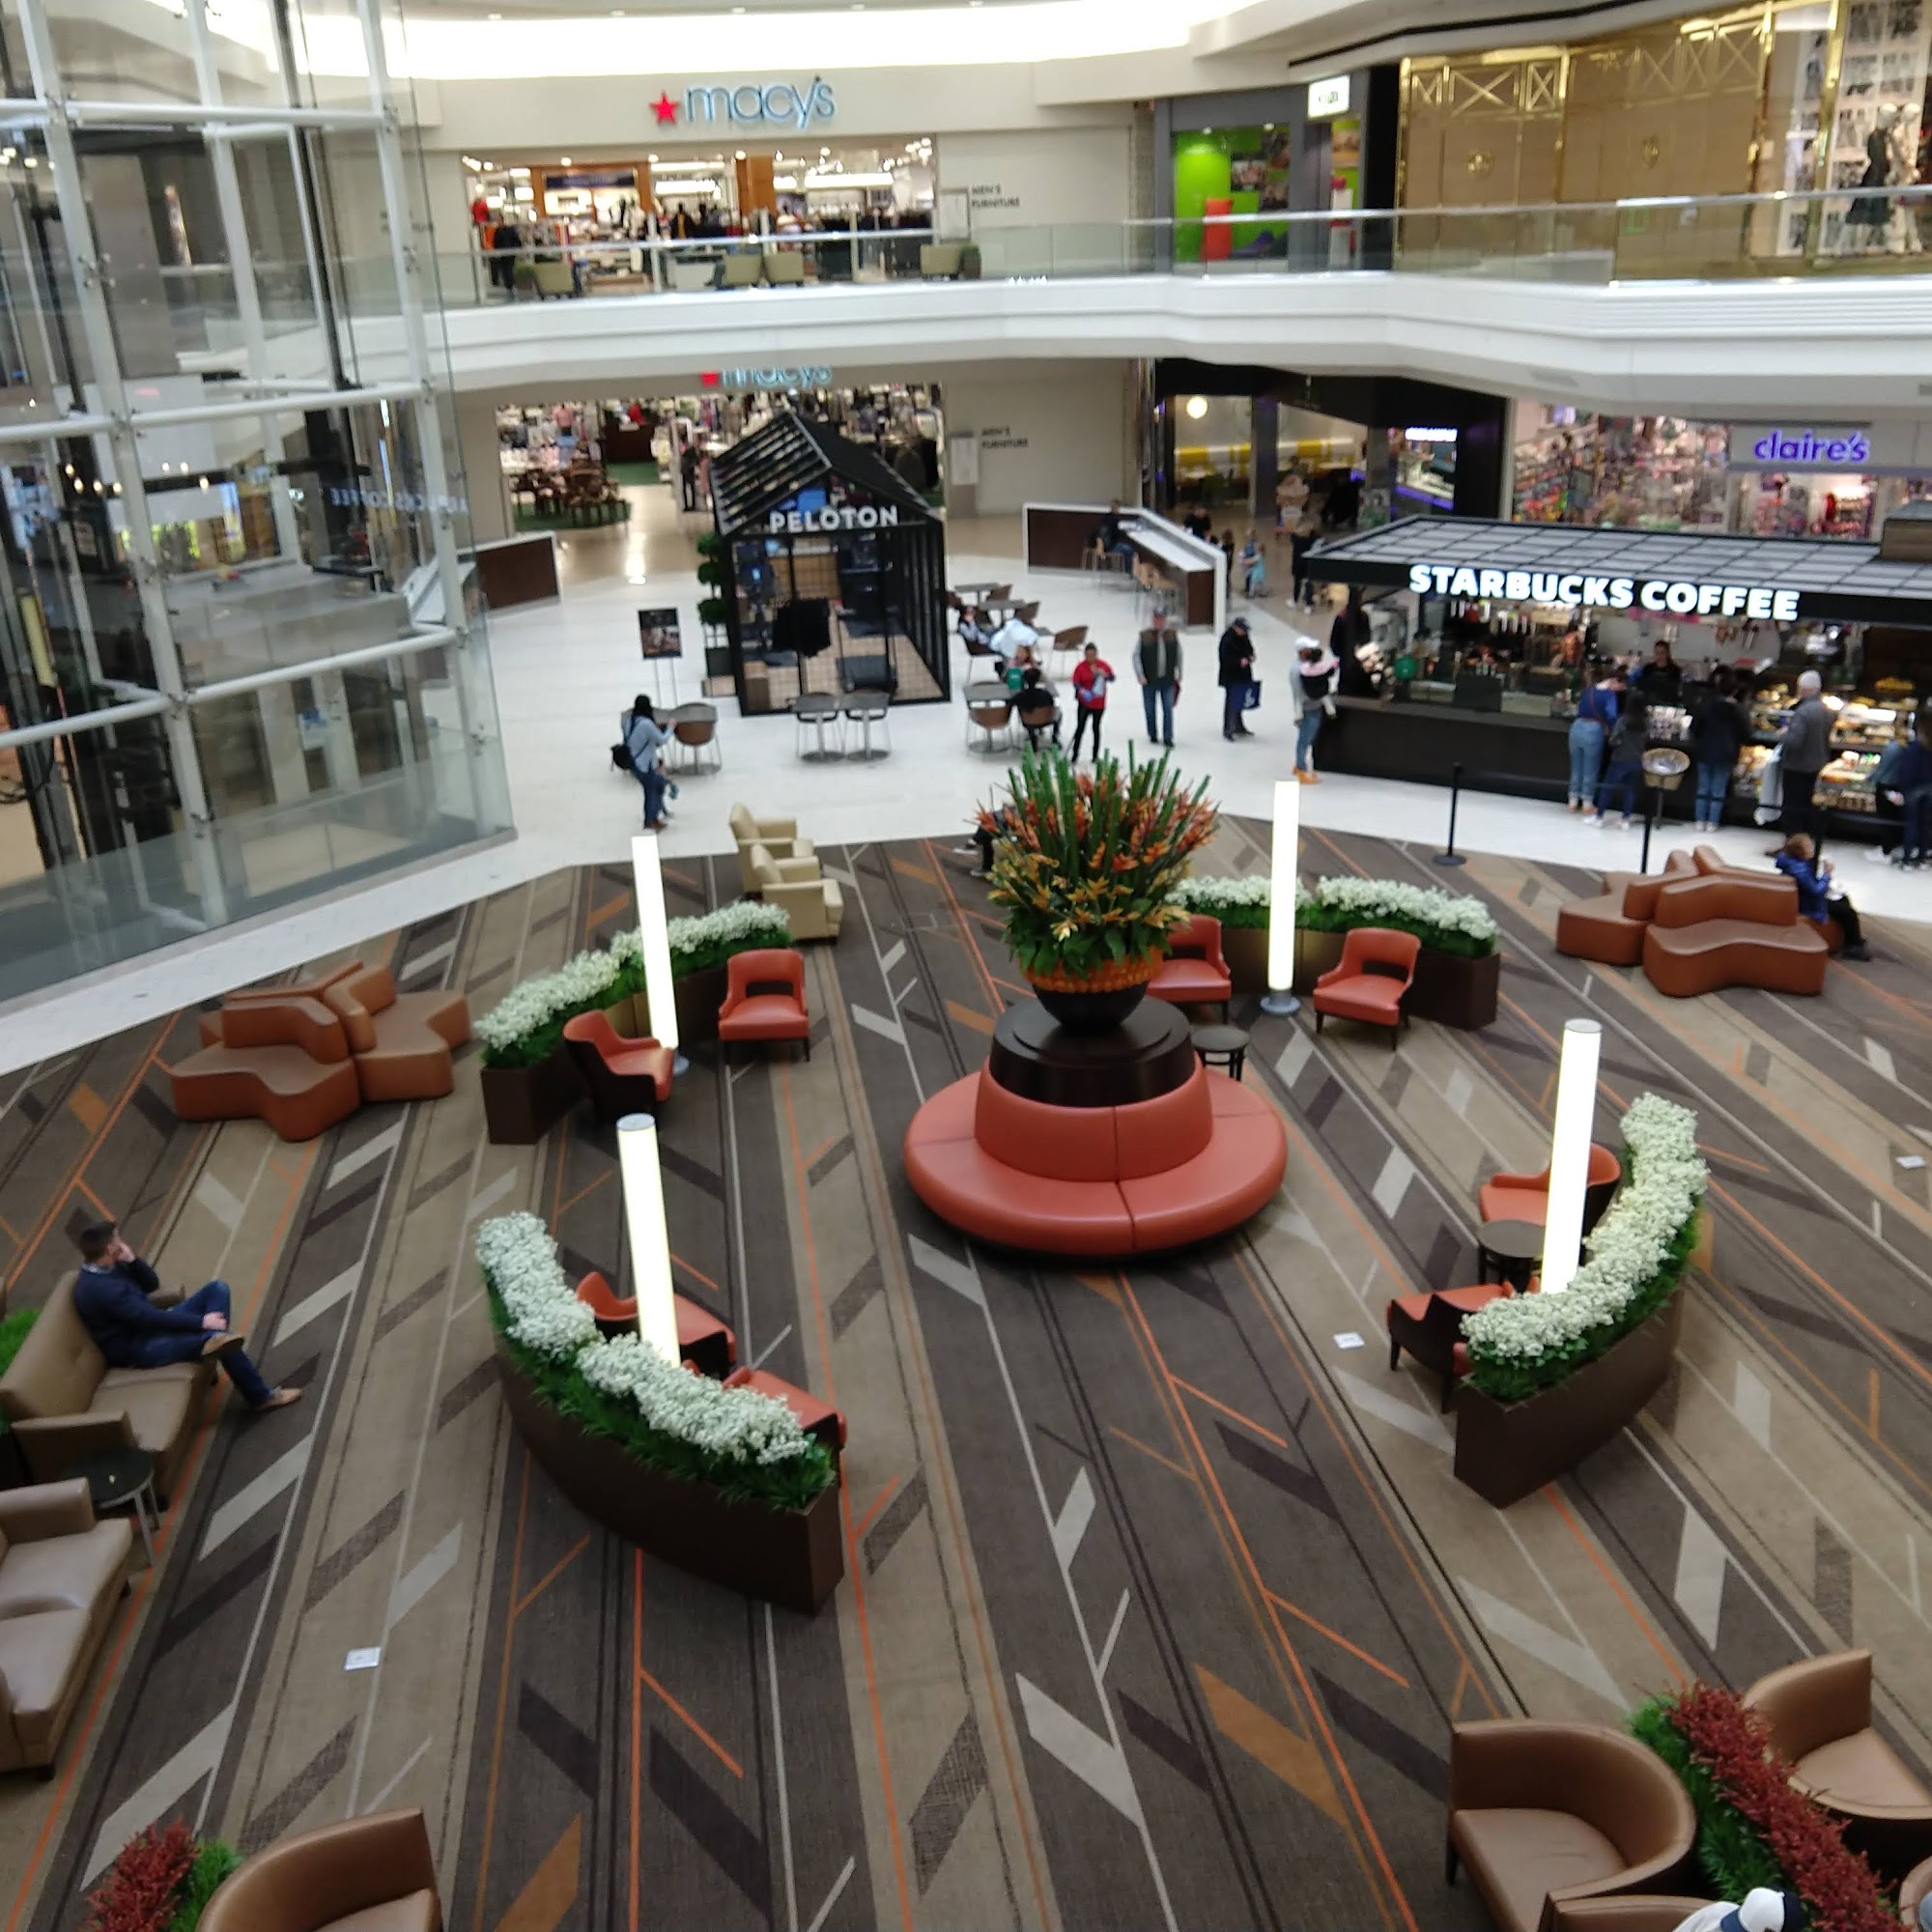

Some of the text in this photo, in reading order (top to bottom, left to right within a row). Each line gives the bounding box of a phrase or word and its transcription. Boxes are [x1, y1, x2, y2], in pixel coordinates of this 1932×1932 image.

[684, 75, 836, 130] macy's
[1753, 428, 1871, 463] claire's
[769, 504, 898, 533] PELOTON
[1409, 564, 1800, 621] STARBUCKS COFFEE
